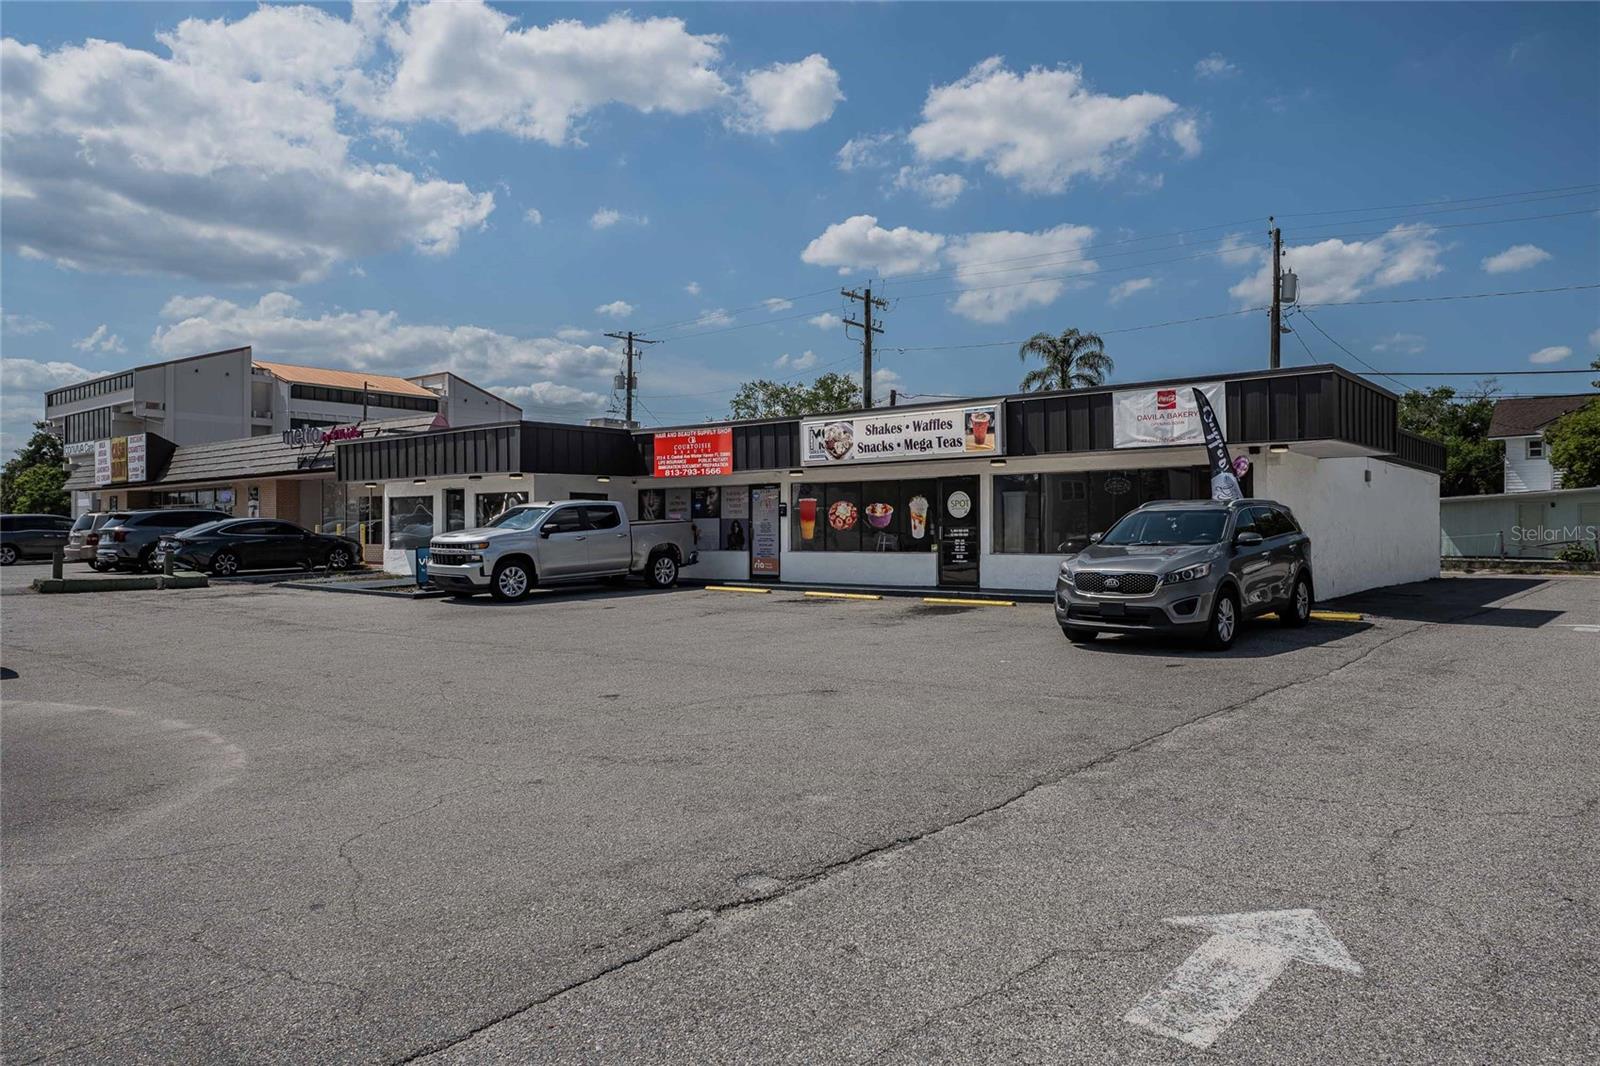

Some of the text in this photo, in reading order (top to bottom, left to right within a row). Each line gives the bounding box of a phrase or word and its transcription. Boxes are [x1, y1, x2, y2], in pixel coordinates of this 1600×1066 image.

[1166, 410, 1199, 420] BAKERY
[865, 418, 954, 437] Shakes Waffles
[857, 436, 963, 454] Snacks Mega Teas
[665, 468, 721, 476] 813-793-1566
[950, 500, 969, 508] SPOT
